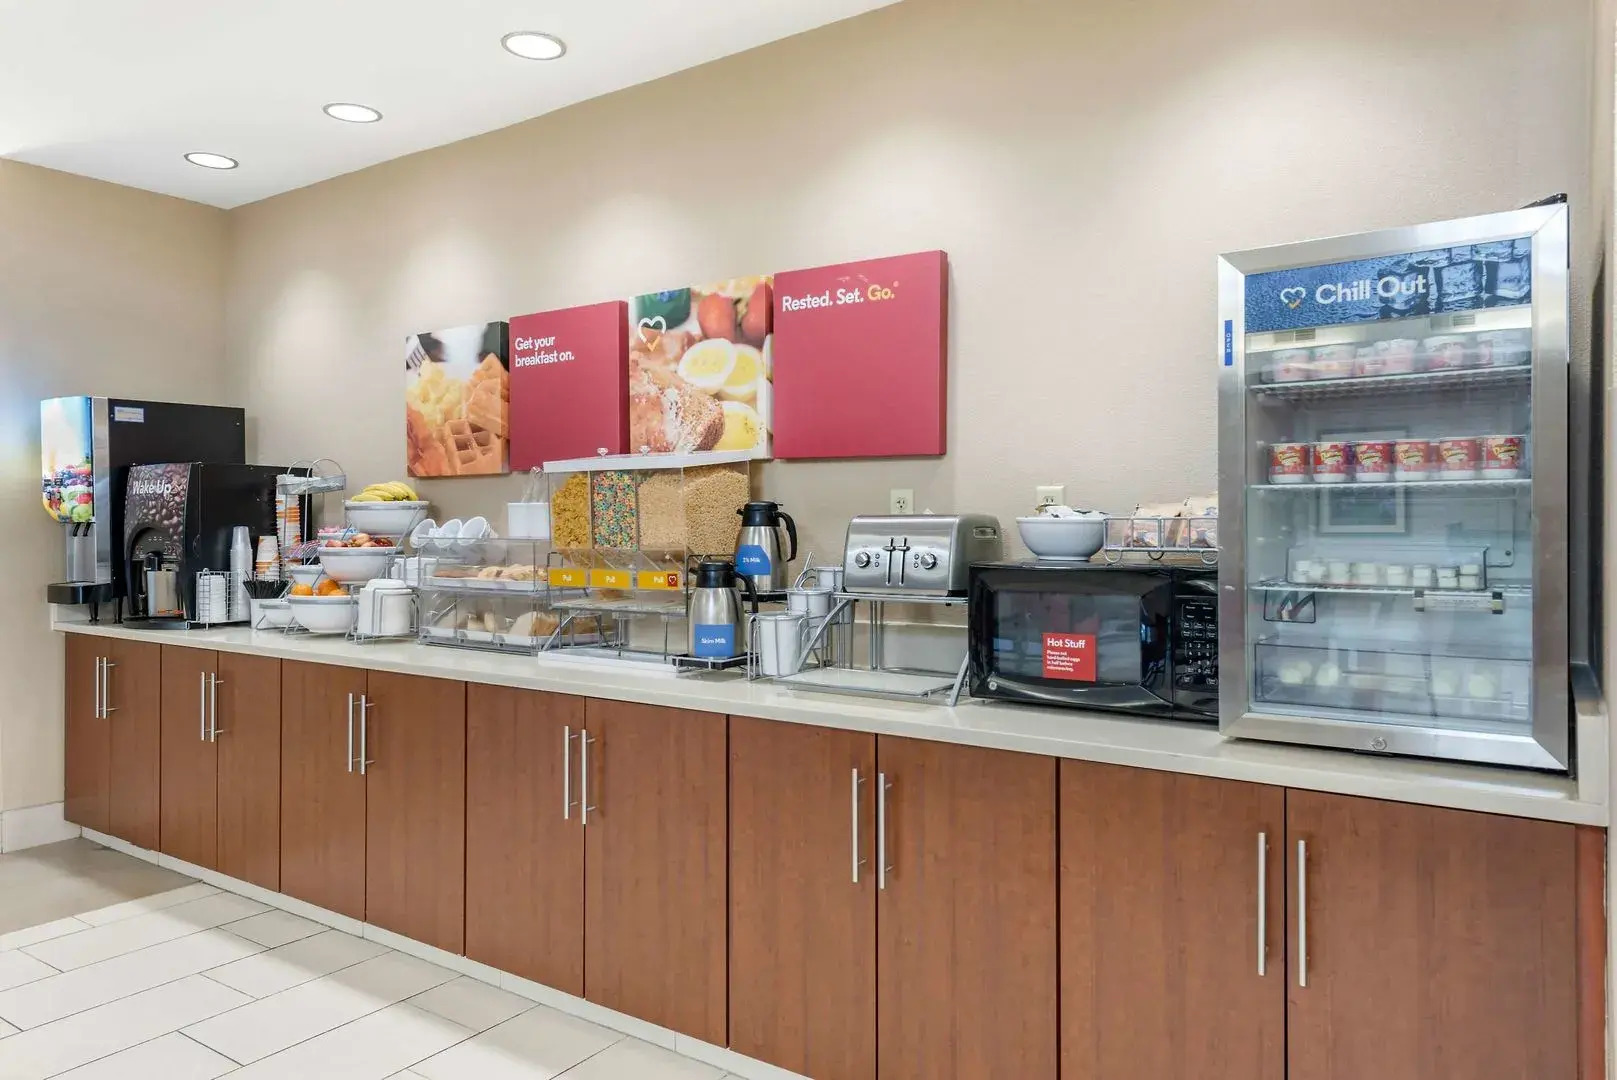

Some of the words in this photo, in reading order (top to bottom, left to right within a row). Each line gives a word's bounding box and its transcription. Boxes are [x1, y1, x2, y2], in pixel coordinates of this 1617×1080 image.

[782, 290, 834, 312] Rested.
[836, 287, 865, 304] Set.
[1315, 279, 1371, 305] Chill
[1376, 275, 1427, 298] Out
[515, 337, 533, 350] Get
[534, 336, 556, 351] your
[515, 350, 558, 367] breakfast
[559, 350, 575, 361] on.
[132, 480, 155, 495] Wake
[156, 479, 172, 500] Up
[1047, 637, 1063, 648] Hot
[1064, 638, 1086, 649] Stuff
